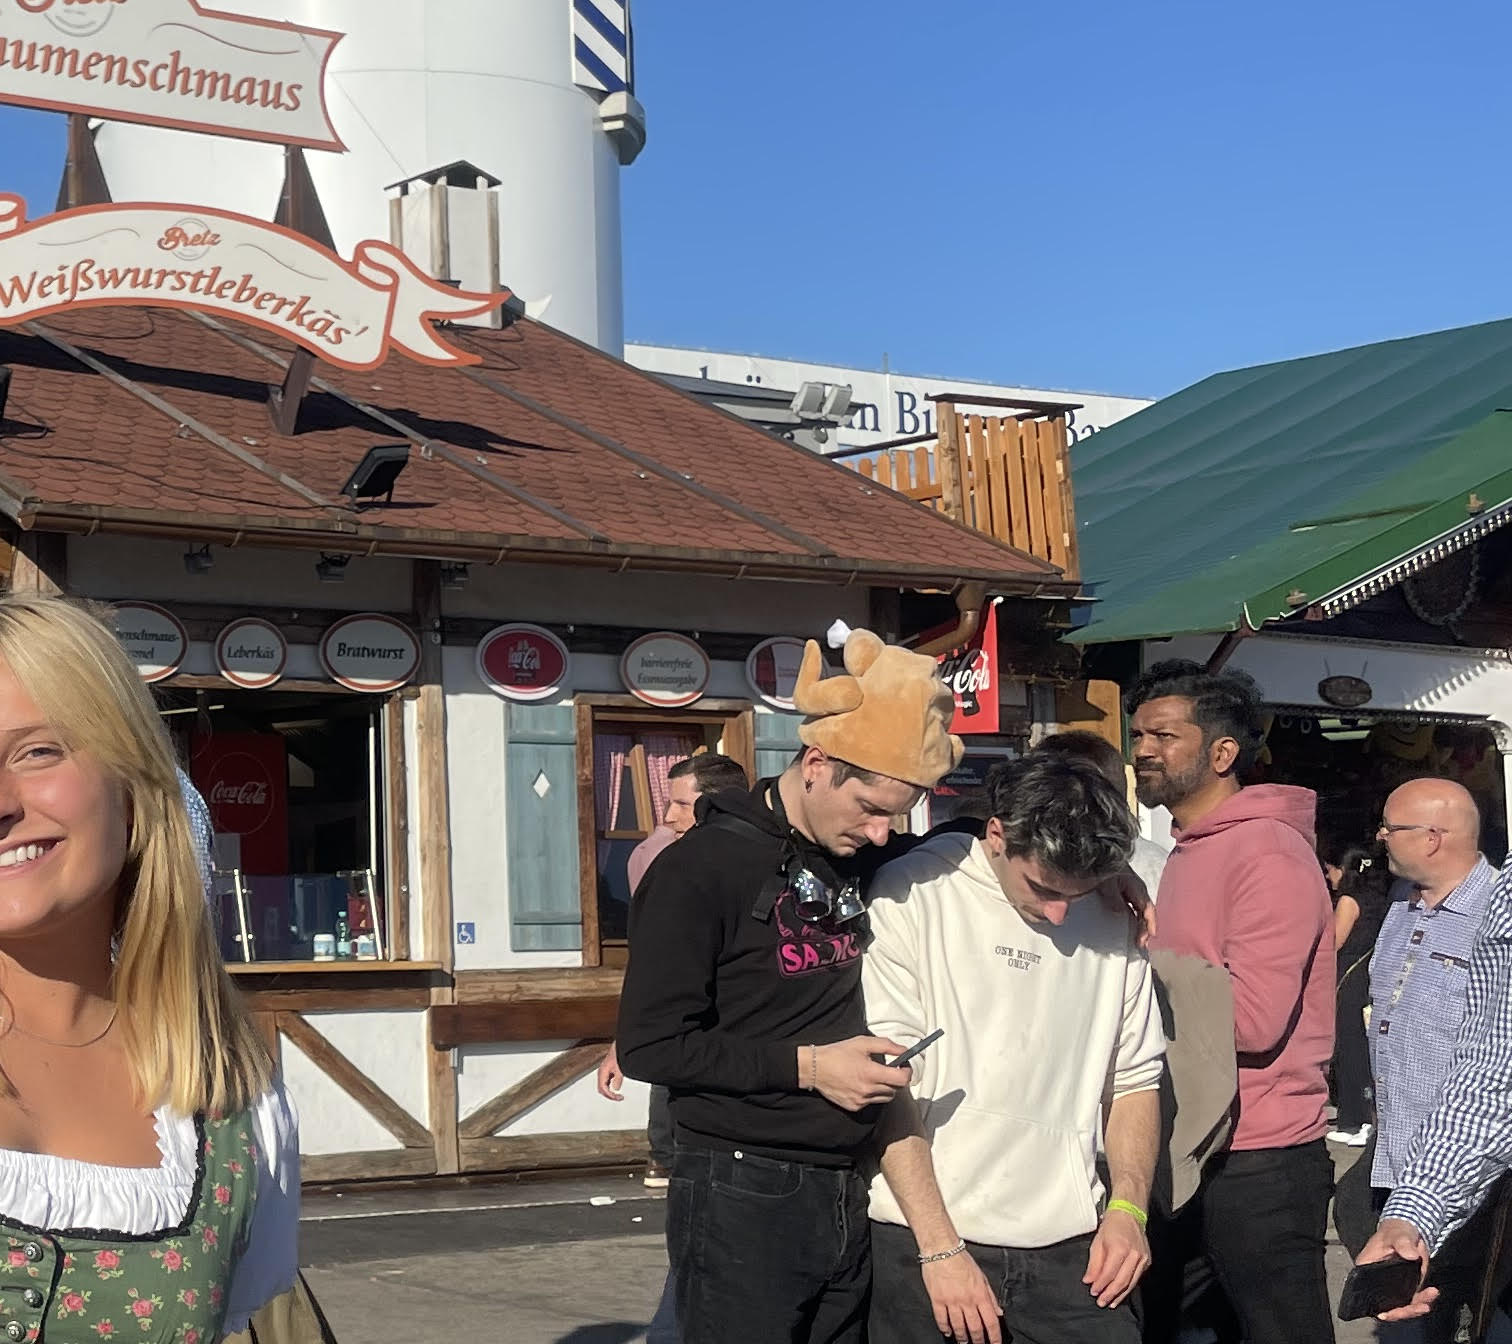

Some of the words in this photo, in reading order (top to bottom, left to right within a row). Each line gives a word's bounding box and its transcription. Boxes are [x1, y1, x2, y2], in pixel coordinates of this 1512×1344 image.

[157, 226, 222, 251] Bretz
[337, 642, 406, 660] Bratwurst
[994, 945, 1015, 958] ONE
[1017, 948, 1042, 965] NIGHT
[1007, 957, 1031, 971] ONLY
